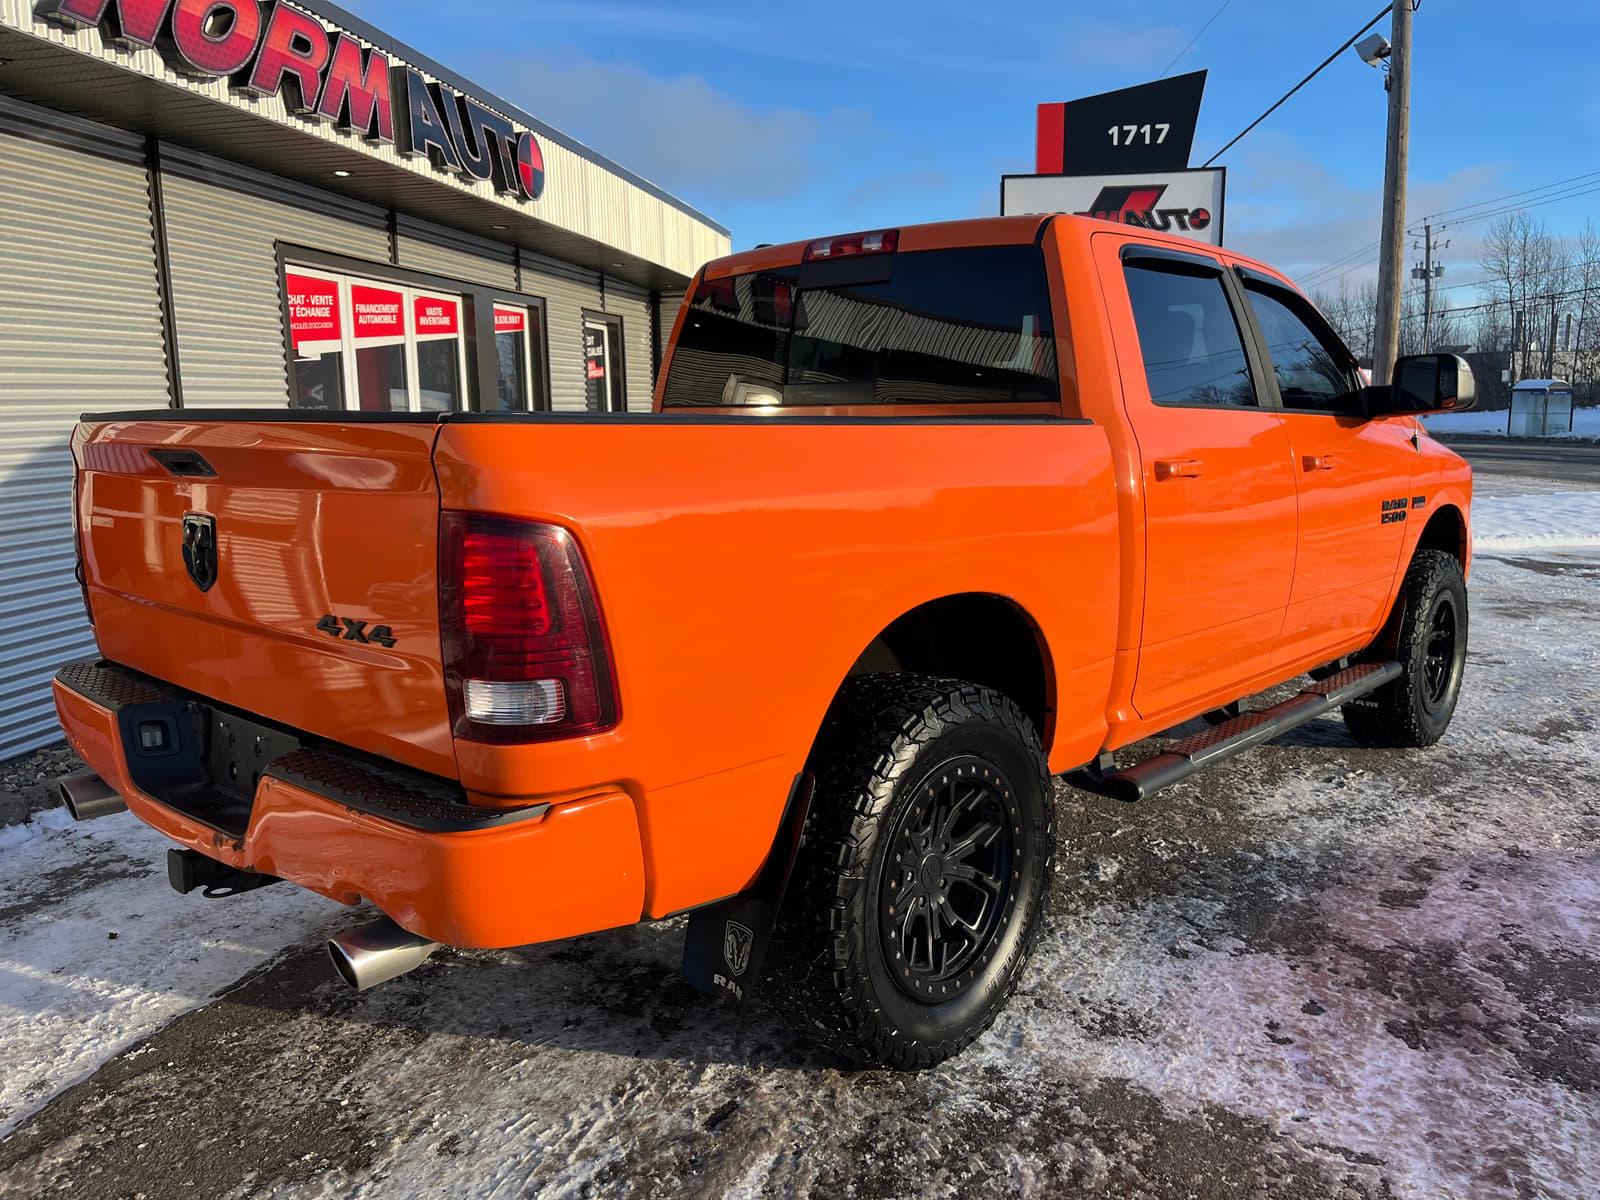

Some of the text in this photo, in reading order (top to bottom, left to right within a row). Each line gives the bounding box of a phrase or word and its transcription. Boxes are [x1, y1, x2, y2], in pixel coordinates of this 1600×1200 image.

[404, 65, 545, 201] AUTO
[1107, 123, 1170, 146] 1717
[310, 295, 334, 306] VENTE
[296, 304, 331, 318] ÉCHANGE
[355, 303, 399, 314] FINANCEMENT
[425, 307, 443, 316] VASTE
[358, 314, 398, 324] AUTOMOBILE
[419, 316, 451, 326] INVENTAIRE
[1381, 510, 1407, 525] 1500
